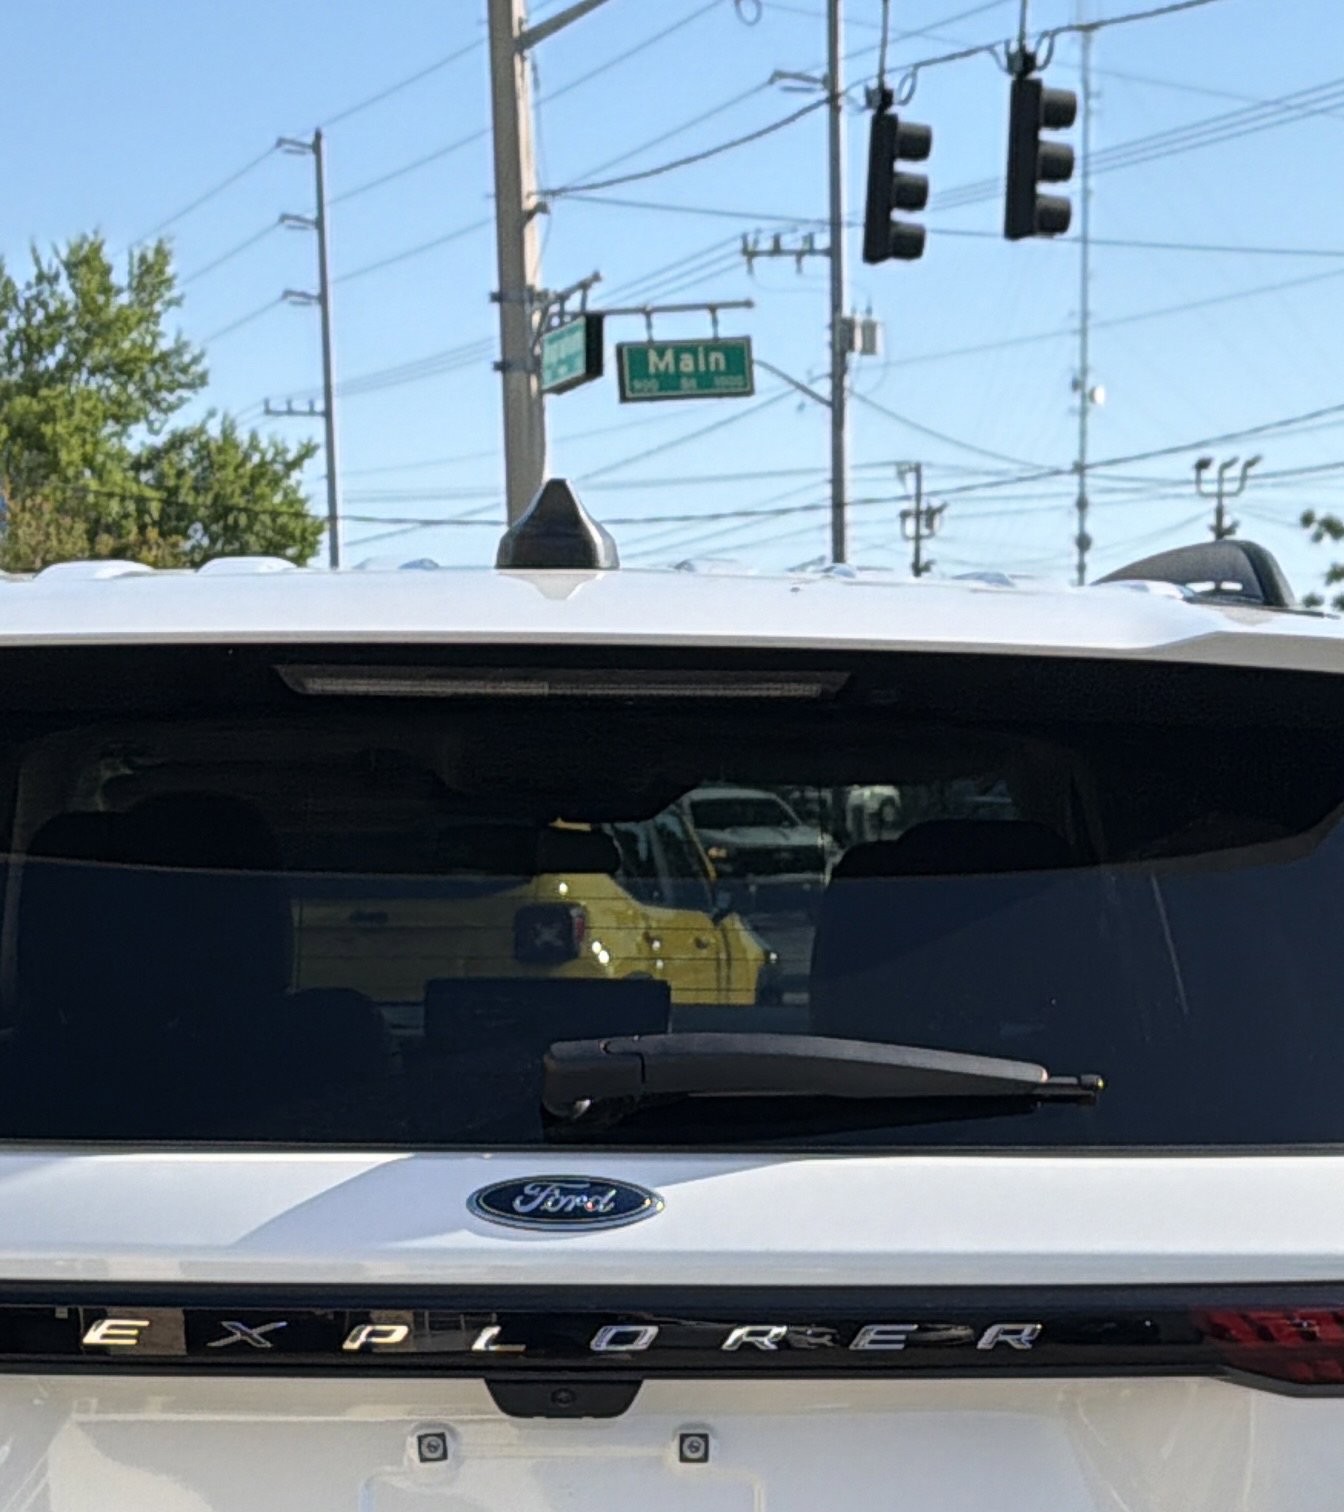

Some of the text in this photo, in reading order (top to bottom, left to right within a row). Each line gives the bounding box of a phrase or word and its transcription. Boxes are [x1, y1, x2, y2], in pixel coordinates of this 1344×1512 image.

[648, 345, 726, 374] Main
[512, 1182, 617, 1213] Ford
[82, 1318, 1043, 1354] EXPLORER
